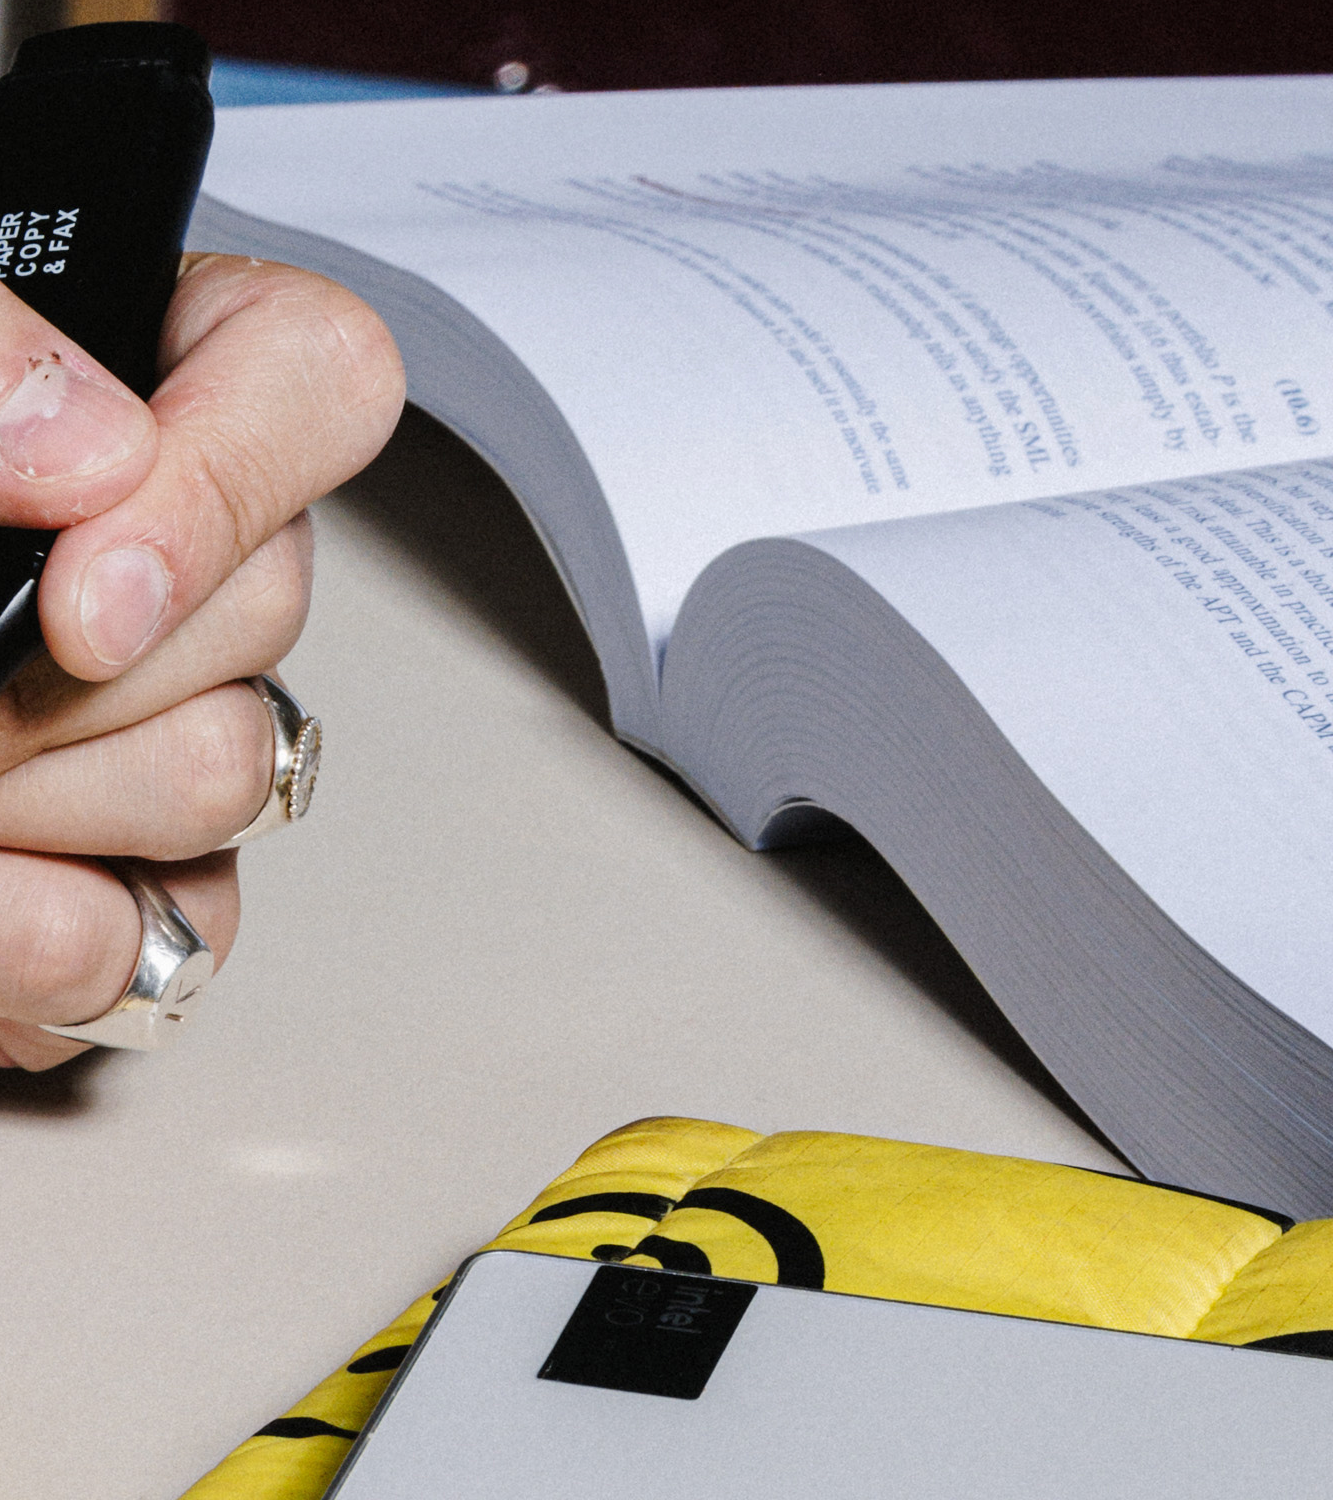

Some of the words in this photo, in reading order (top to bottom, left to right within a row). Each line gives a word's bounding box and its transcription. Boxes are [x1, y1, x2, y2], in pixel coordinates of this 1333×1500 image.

[15, 211, 50, 276] COPY
[48, 208, 80, 252] FAX
[42, 259, 66, 274] &
[948, 373, 969, 393] us
[961, 396, 1012, 478] anything
[995, 389, 1023, 416] the
[1013, 421, 1051, 473] SML
[1009, 353, 1082, 468] opportunities
[1130, 364, 1175, 420] simply
[1163, 427, 1188, 451] by
[1221, 392, 1241, 408] is
[1232, 413, 1257, 444] the
[1275, 379, 1317, 436] (10.6)
[840, 426, 881, 494] motivate
[869, 421, 891, 444] the
[883, 449, 911, 490] same
[1163, 526, 1182, 534] a
[1180, 506, 1216, 524] risk
[1170, 536, 1225, 565] good
[1206, 525, 1278, 581] attainable
[1245, 518, 1282, 544] This
[1274, 545, 1293, 557] is
[1287, 559, 1306, 568] a
[1212, 568, 1312, 666] approximation
[1269, 583, 1293, 599] in
[1097, 511, 1162, 552] strengths
[1155, 555, 1188, 568] of
[1173, 570, 1203, 591] the
[1196, 597, 1243, 624] APT
[1229, 631, 1268, 657] and
[1256, 661, 1287, 685] the
[1282, 689, 1333, 739] CAPM
[1280, 602, 1333, 655] practic
[1306, 670, 1330, 686] to
[655, 1285, 723, 1333] intel
